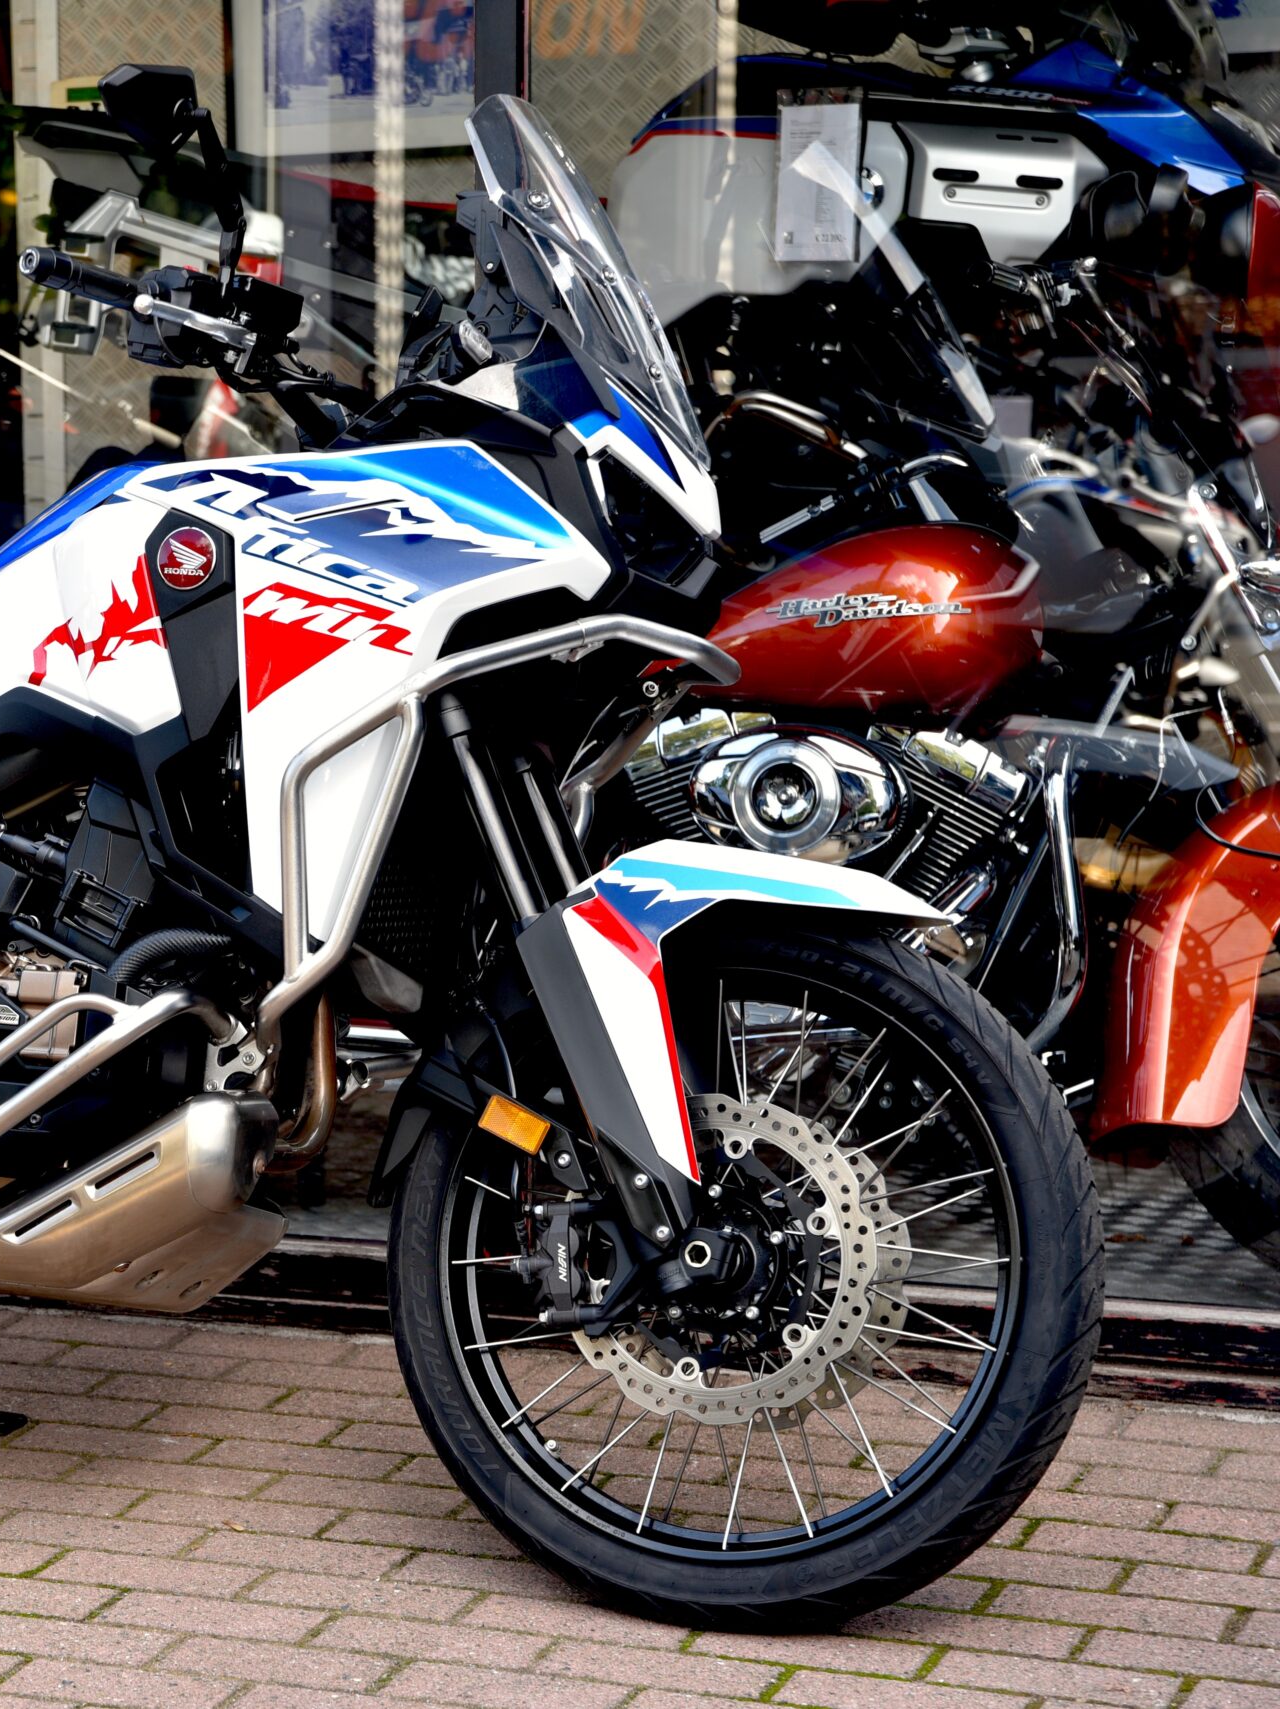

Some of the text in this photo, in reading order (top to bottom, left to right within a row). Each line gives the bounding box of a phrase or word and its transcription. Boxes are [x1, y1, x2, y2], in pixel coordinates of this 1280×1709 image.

[163, 566, 205, 577] HONDA
[765, 592, 898, 620] Harley
[813, 600, 973, 628] Davidson
[556, 1242, 568, 1282] NISSIN
[823, 1413, 1017, 1580] METZELER
